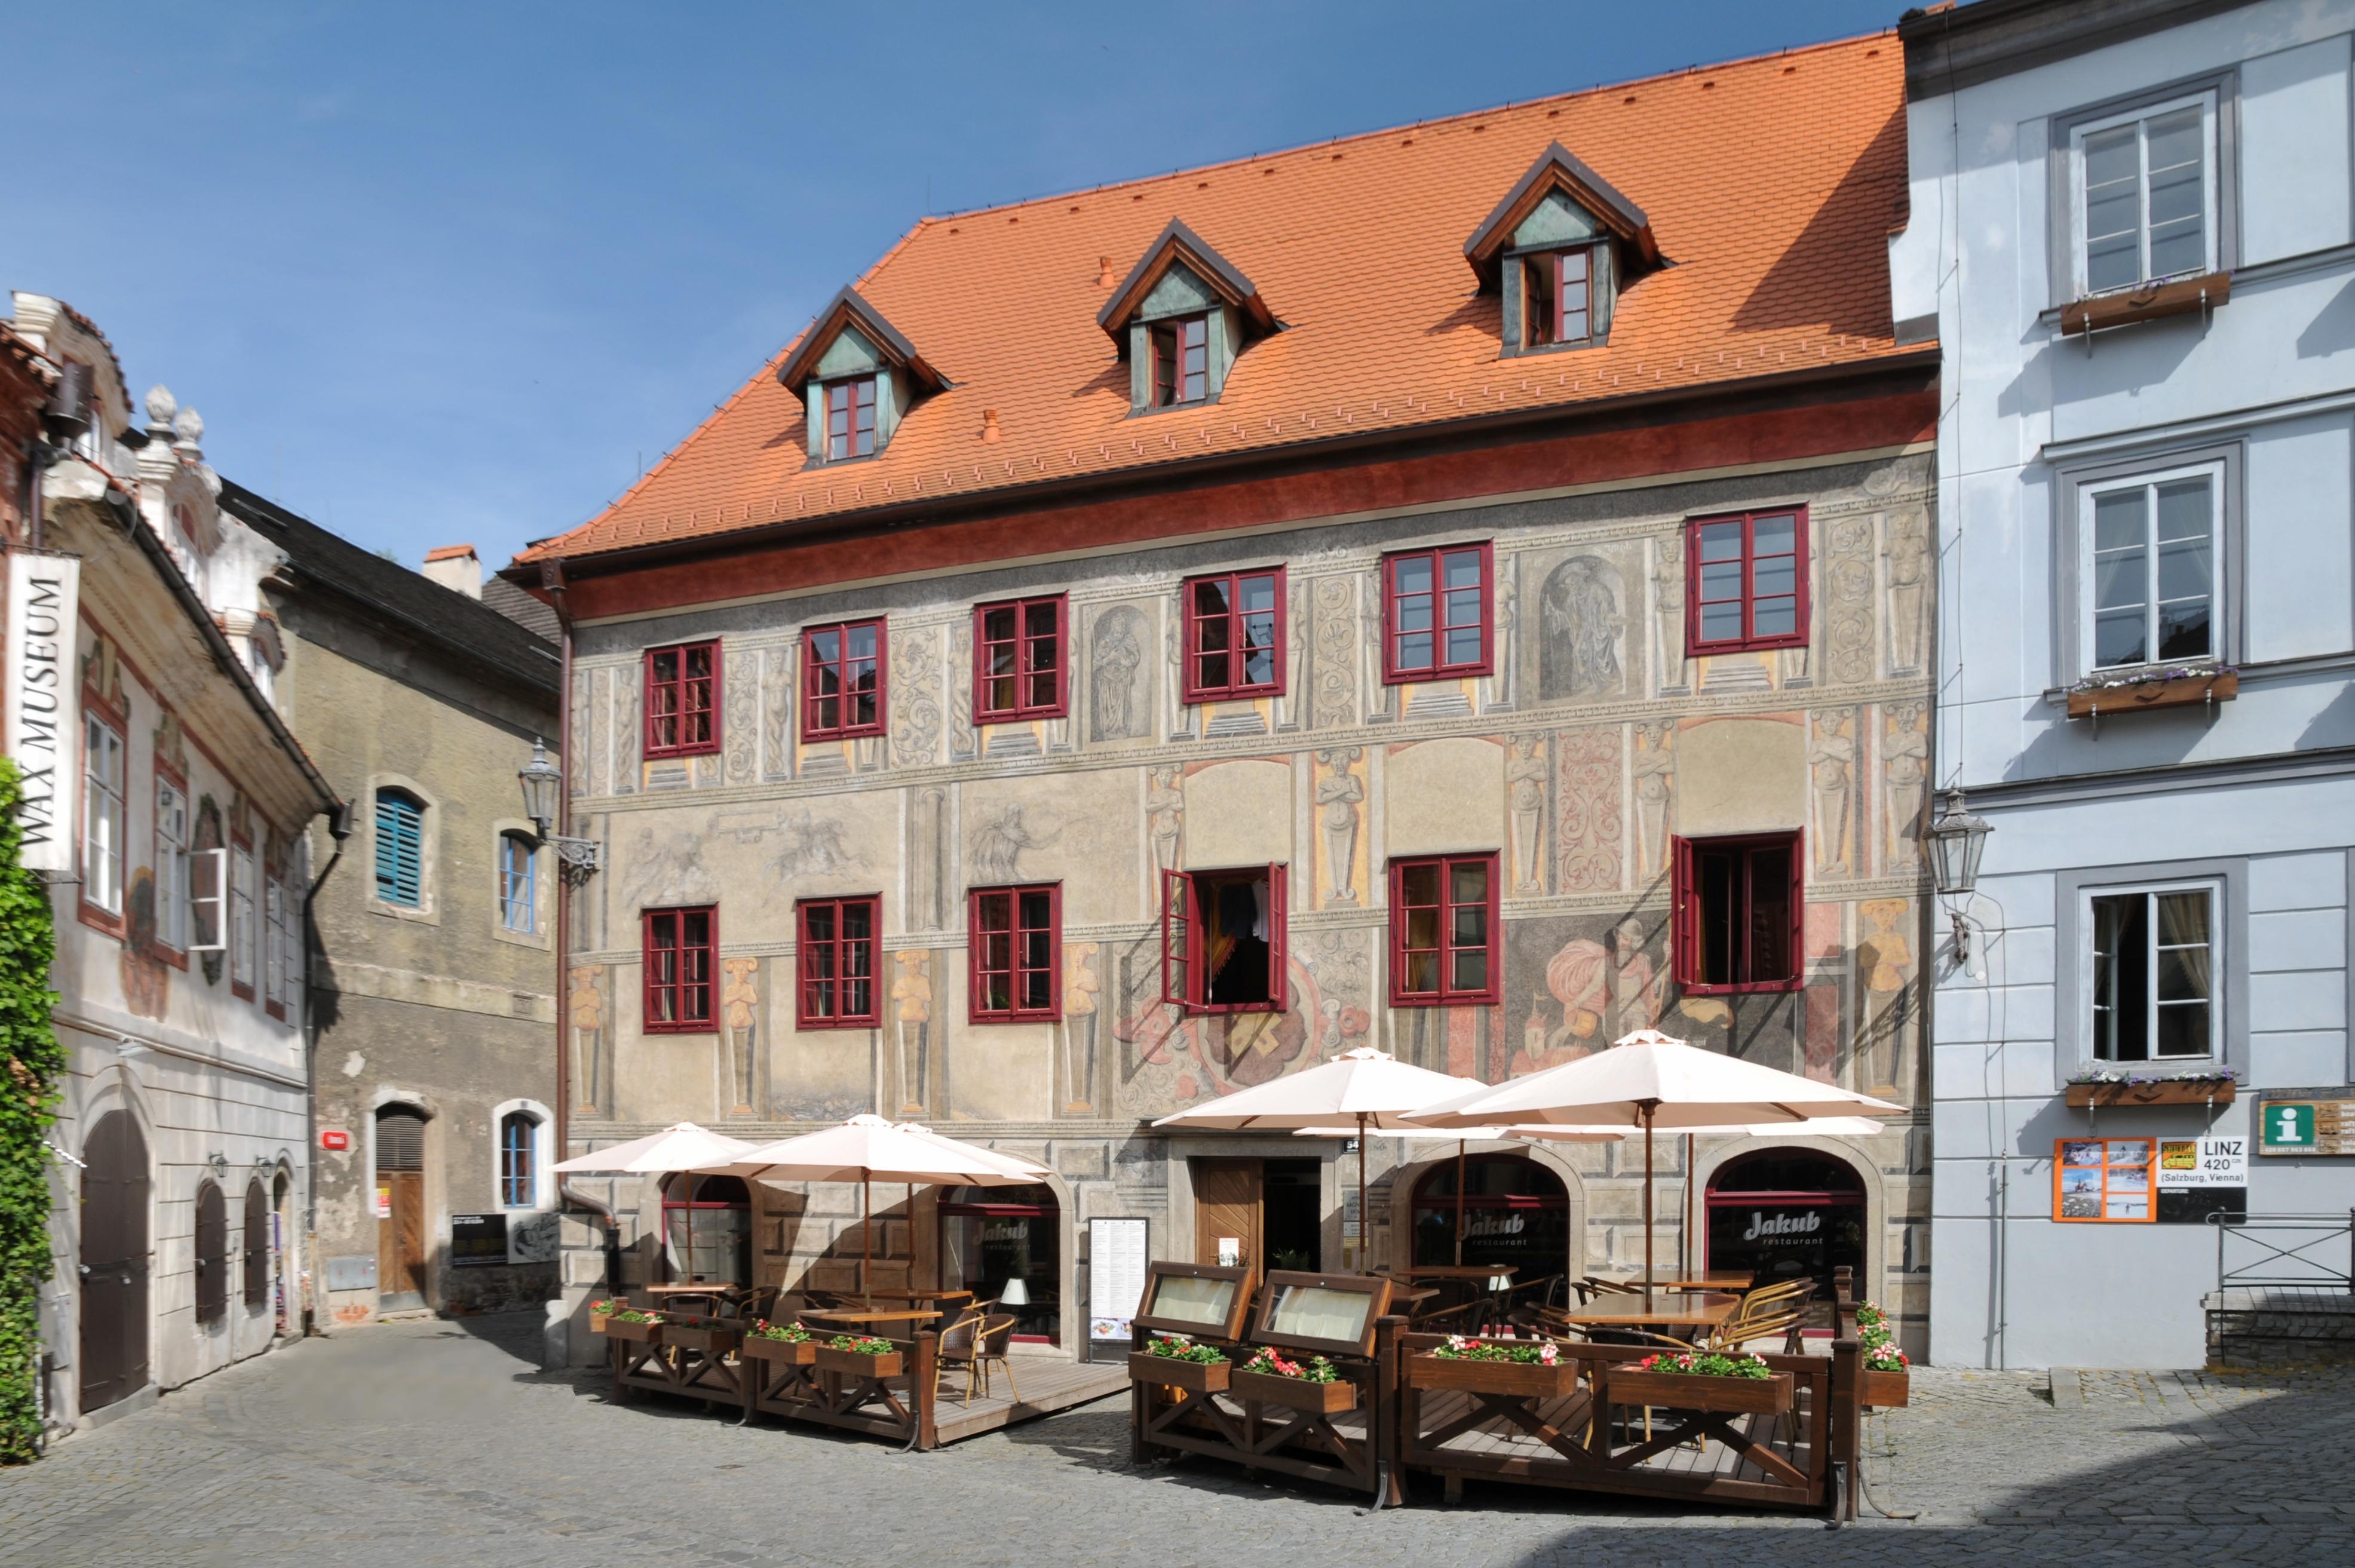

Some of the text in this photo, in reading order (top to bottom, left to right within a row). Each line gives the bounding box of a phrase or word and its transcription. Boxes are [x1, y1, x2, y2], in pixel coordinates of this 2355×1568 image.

[18, 576, 62, 846] WAX MUSEUM
[2163, 1144, 2196, 1152] SHUTTLE
[2205, 1142, 2242, 1155] LINZ
[2204, 1159, 2230, 1170] 420
[2161, 1174, 2244, 1183] (Salzburg, Vienna)
[973, 1222, 1028, 1245] Jakub
[1455, 1214, 1525, 1241] Jakub
[1743, 1211, 1820, 1241] Jakub
